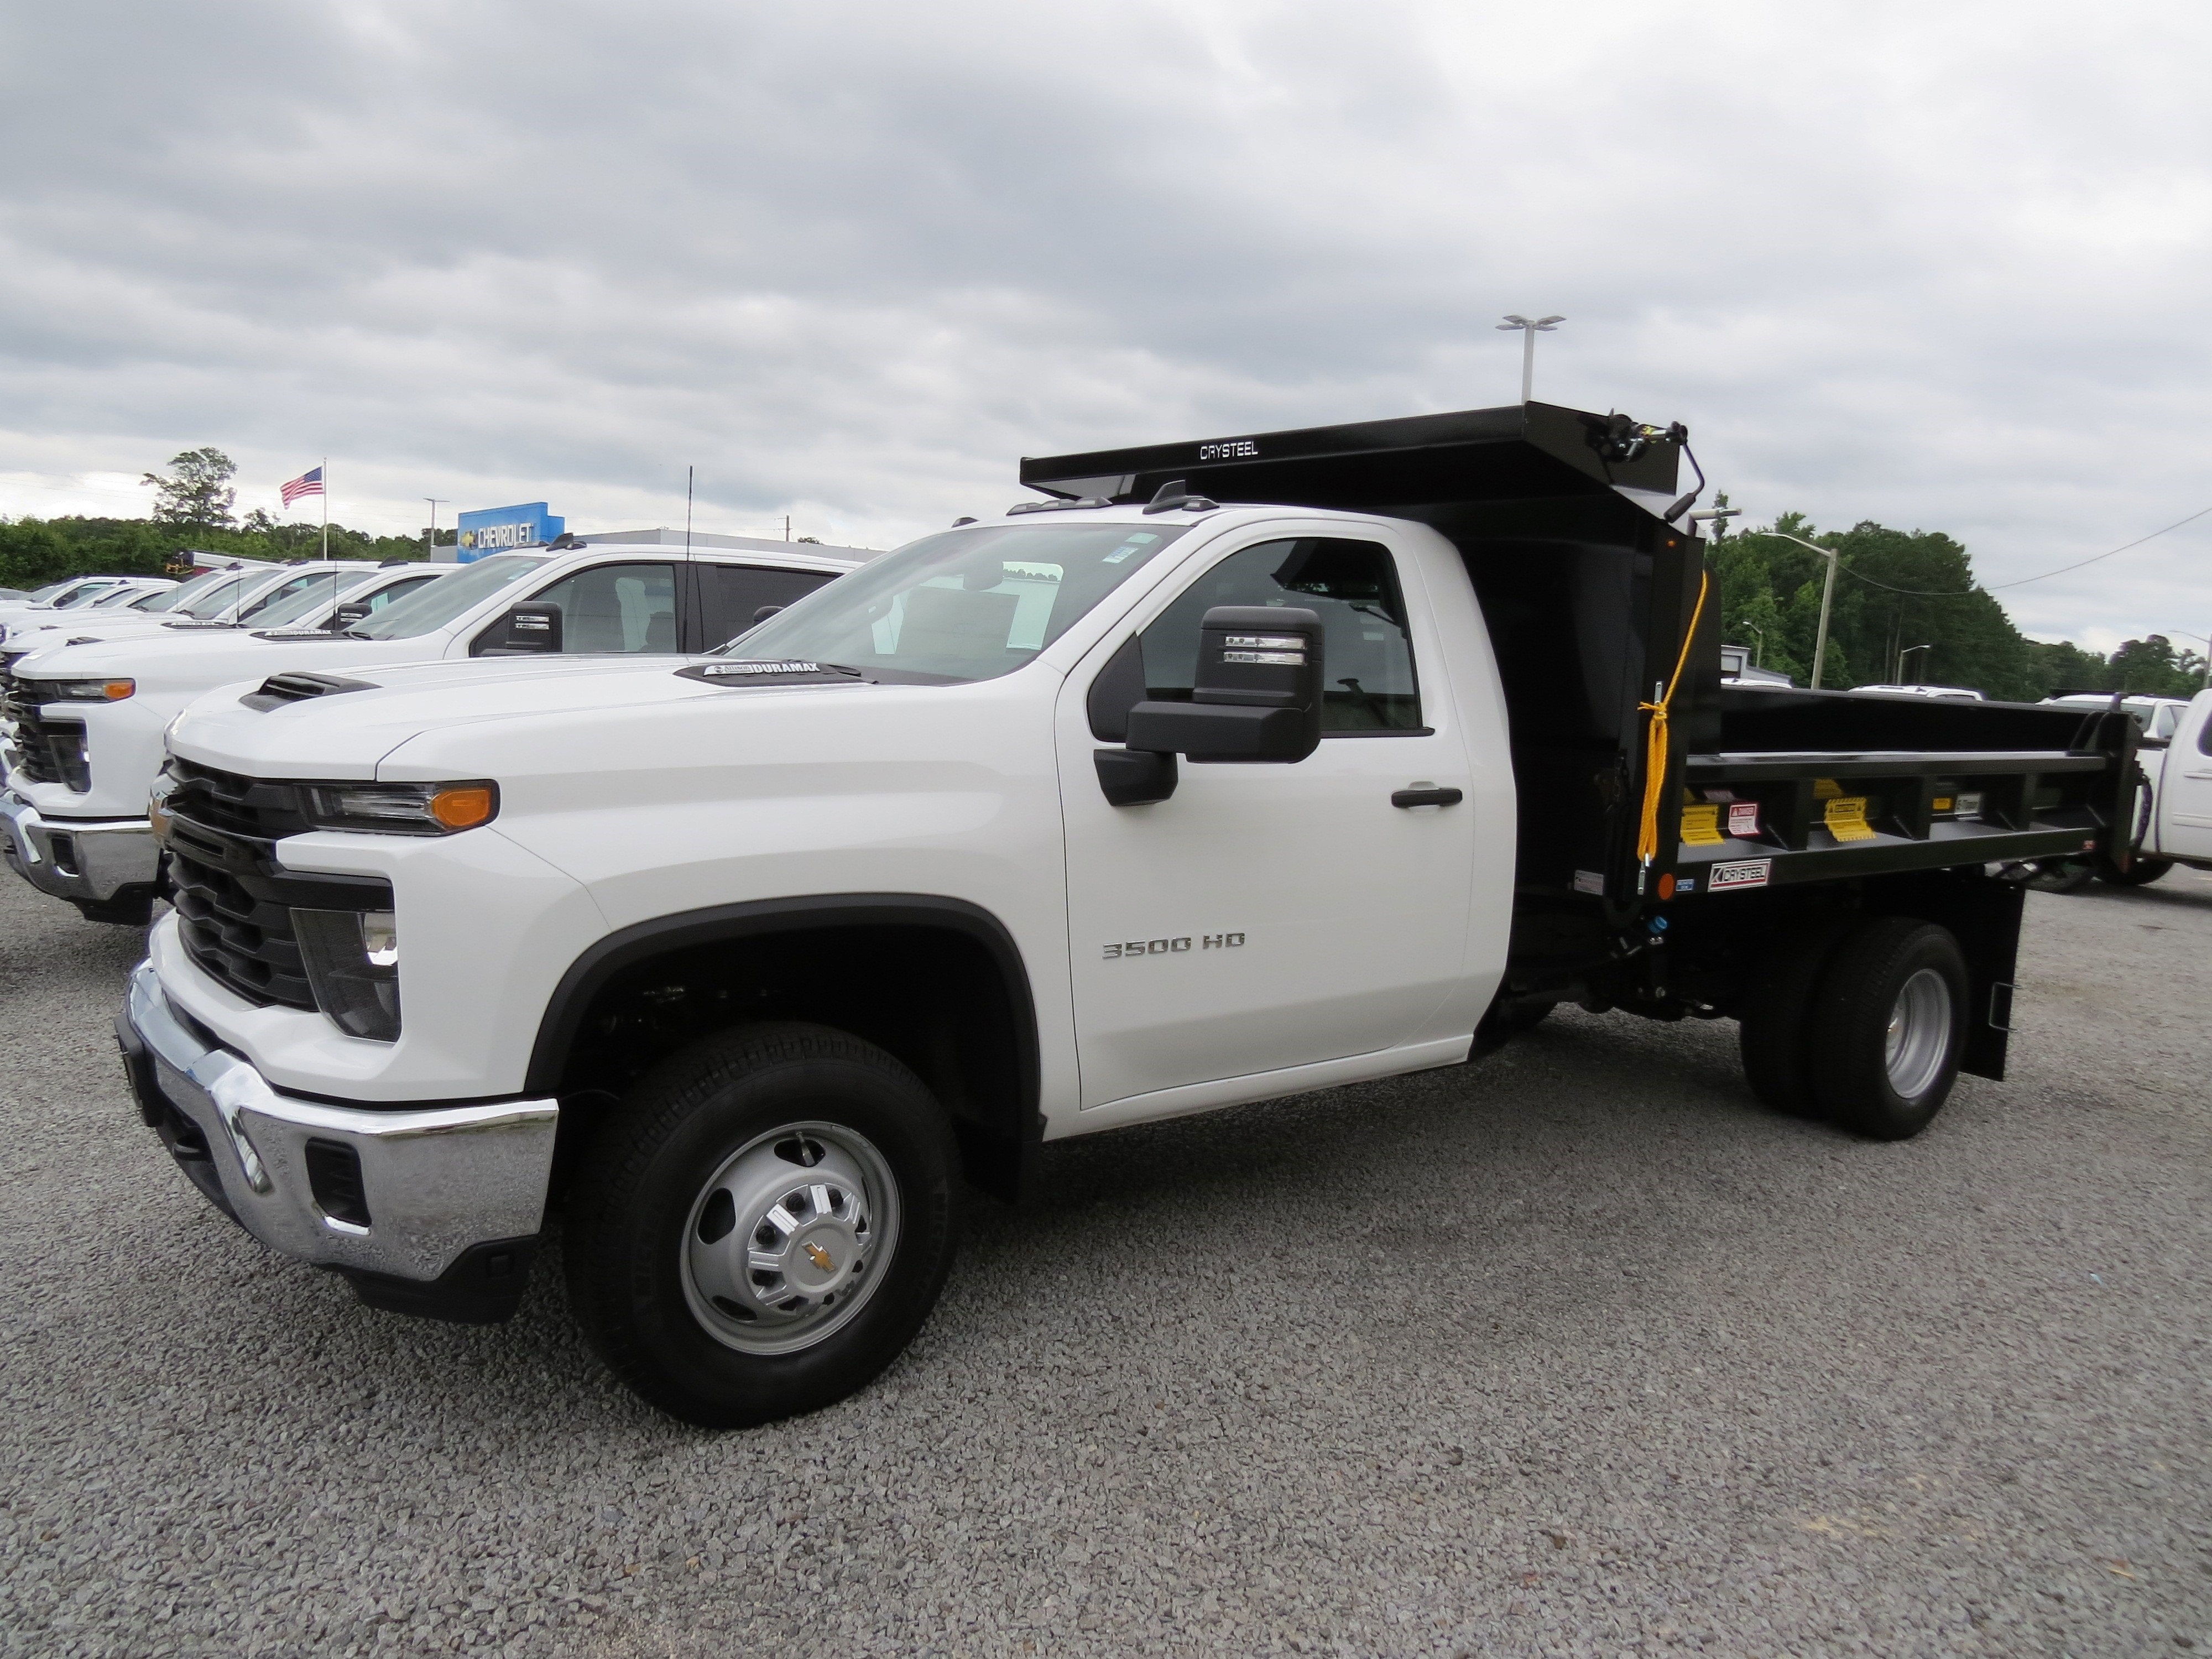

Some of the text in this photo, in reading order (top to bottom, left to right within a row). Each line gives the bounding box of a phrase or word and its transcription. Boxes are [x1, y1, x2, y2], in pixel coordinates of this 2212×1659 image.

[1200, 441, 1258, 460] CRYSTEEL
[478, 523, 532, 549] CHEVROLET
[751, 662, 821, 674] DURAMAX
[1724, 866, 1765, 881] CRYSTEEL
[1102, 932, 1245, 959] 3500 HD
